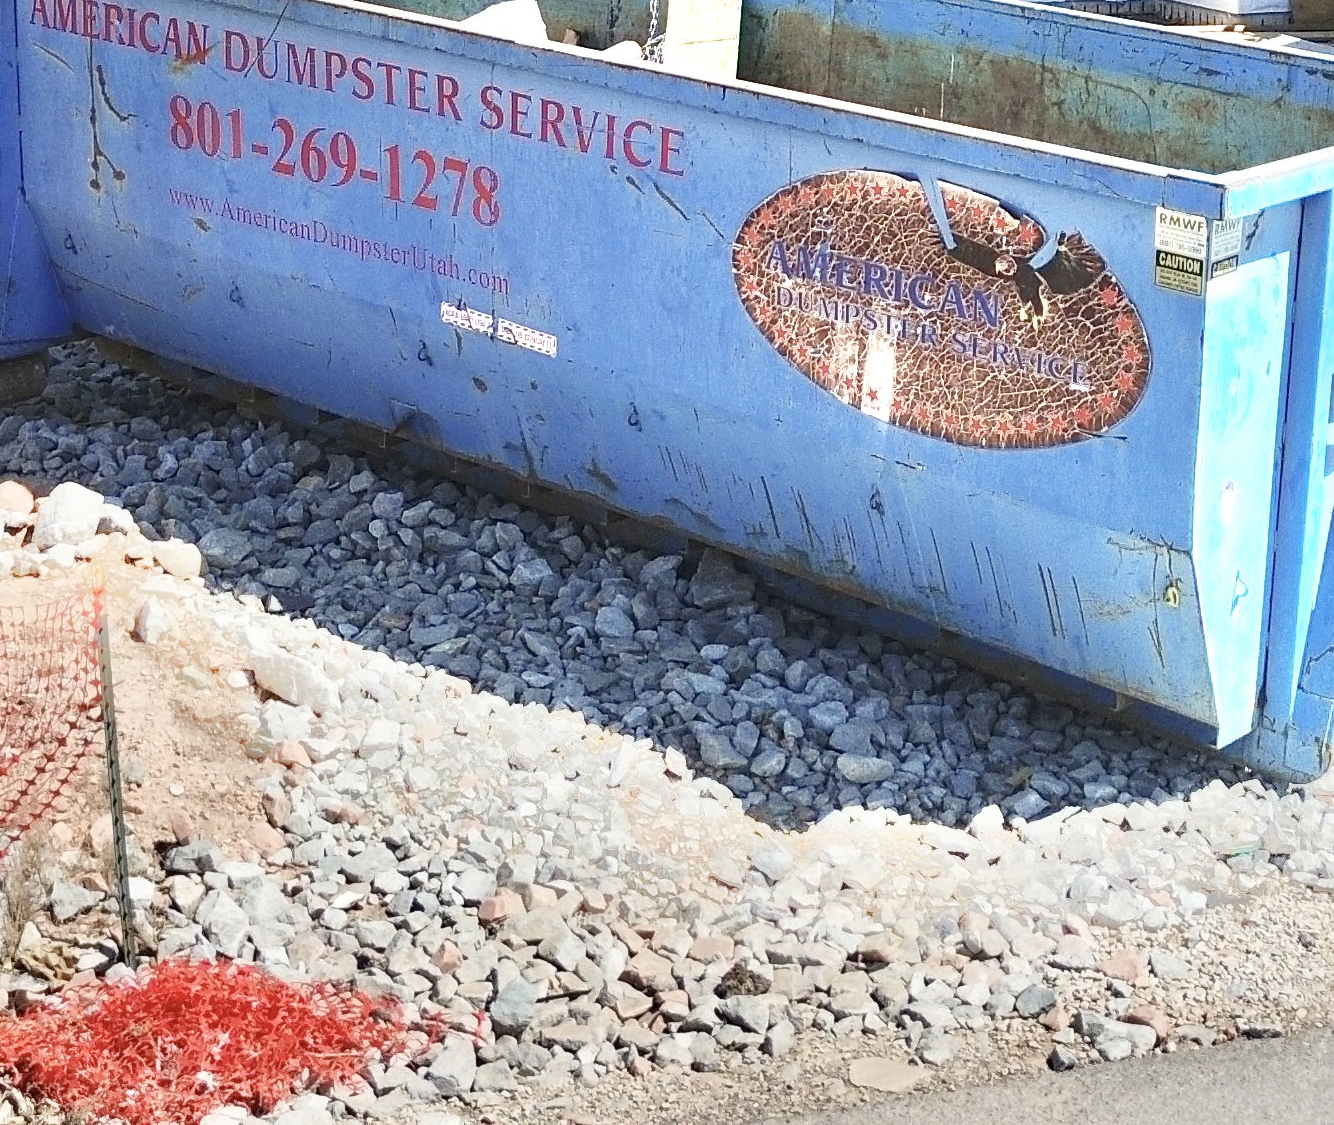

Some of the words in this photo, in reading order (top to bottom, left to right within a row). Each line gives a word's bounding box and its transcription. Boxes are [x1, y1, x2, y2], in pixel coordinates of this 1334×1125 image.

[223, 29, 463, 122] DUMPSTER
[479, 85, 686, 177] SERVICE
[169, 93, 503, 228] 801-269-1278
[168, 187, 511, 297] www.AmericanDumpsterUtah.com
[1158, 252, 1201, 275] CAUTION
[1159, 213, 1205, 233] RMWF
[1214, 218, 1242, 235] RMWF
[767, 238, 1003, 330] AMERICAN
[774, 285, 939, 345] DUMPSTER
[951, 331, 1091, 387] SERVICE
